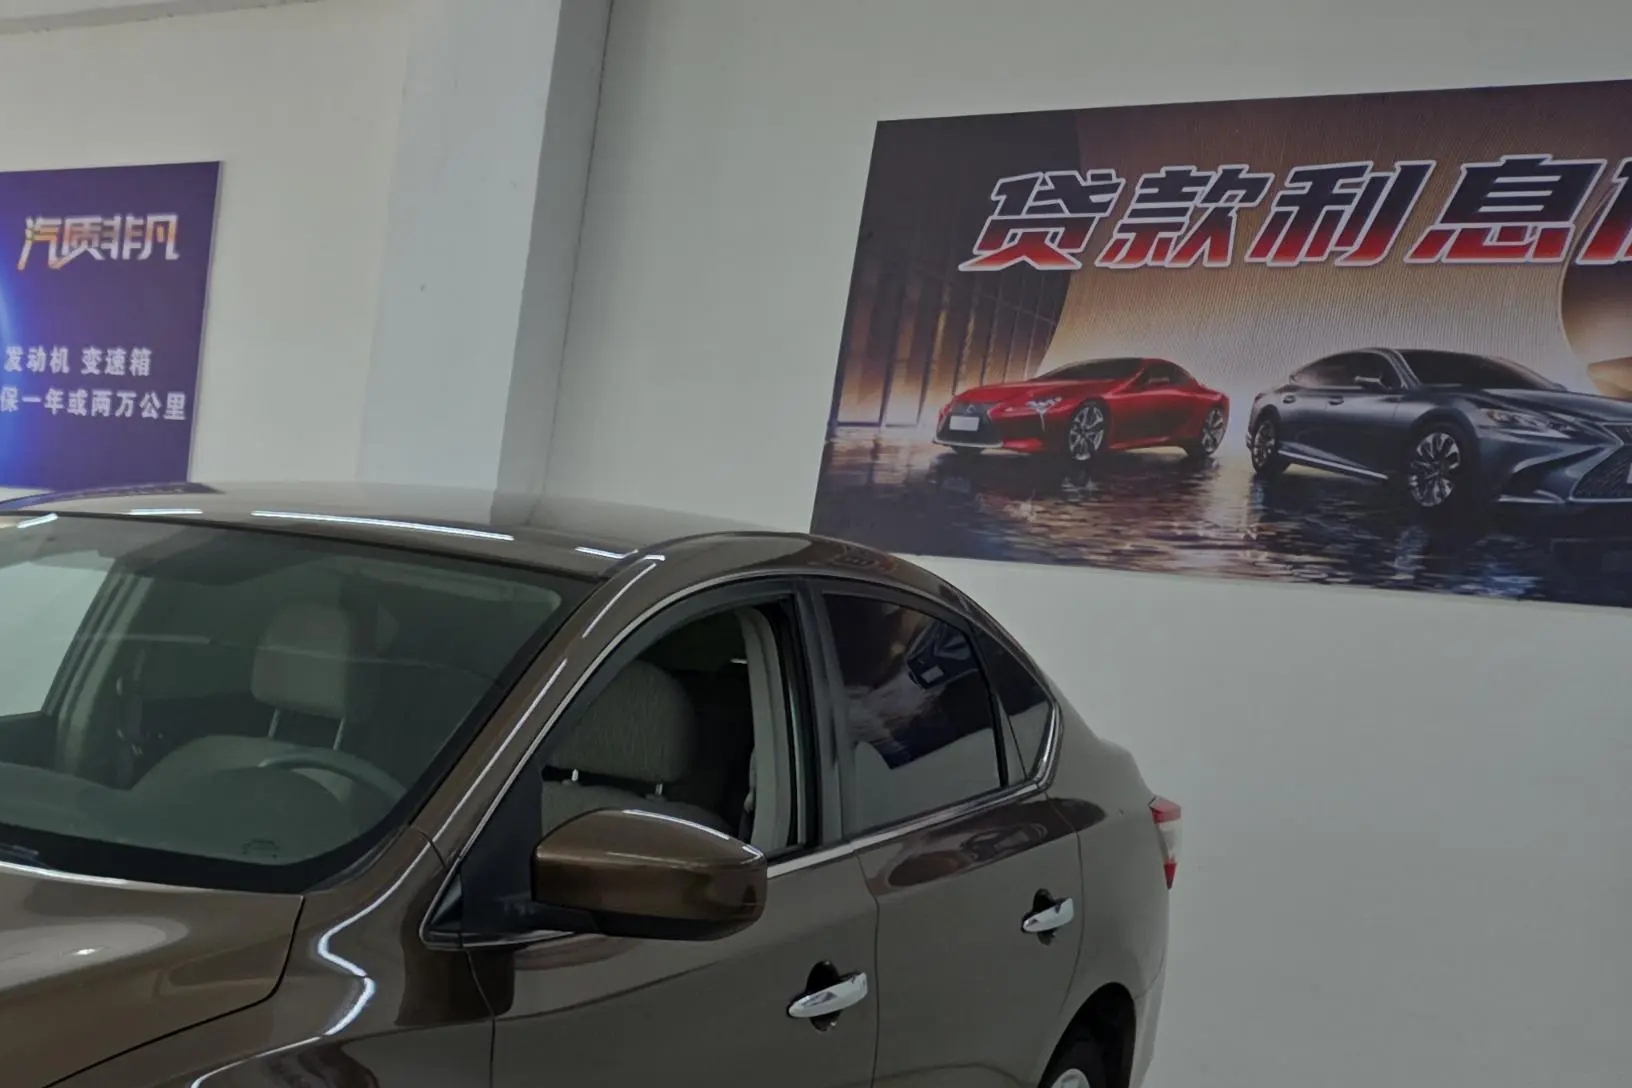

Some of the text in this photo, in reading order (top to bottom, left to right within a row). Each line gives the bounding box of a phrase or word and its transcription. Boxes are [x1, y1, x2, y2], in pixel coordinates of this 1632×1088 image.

[17, 213, 180, 270] 汽质非凡
[3, 346, 152, 376] 发动机 变速箱
